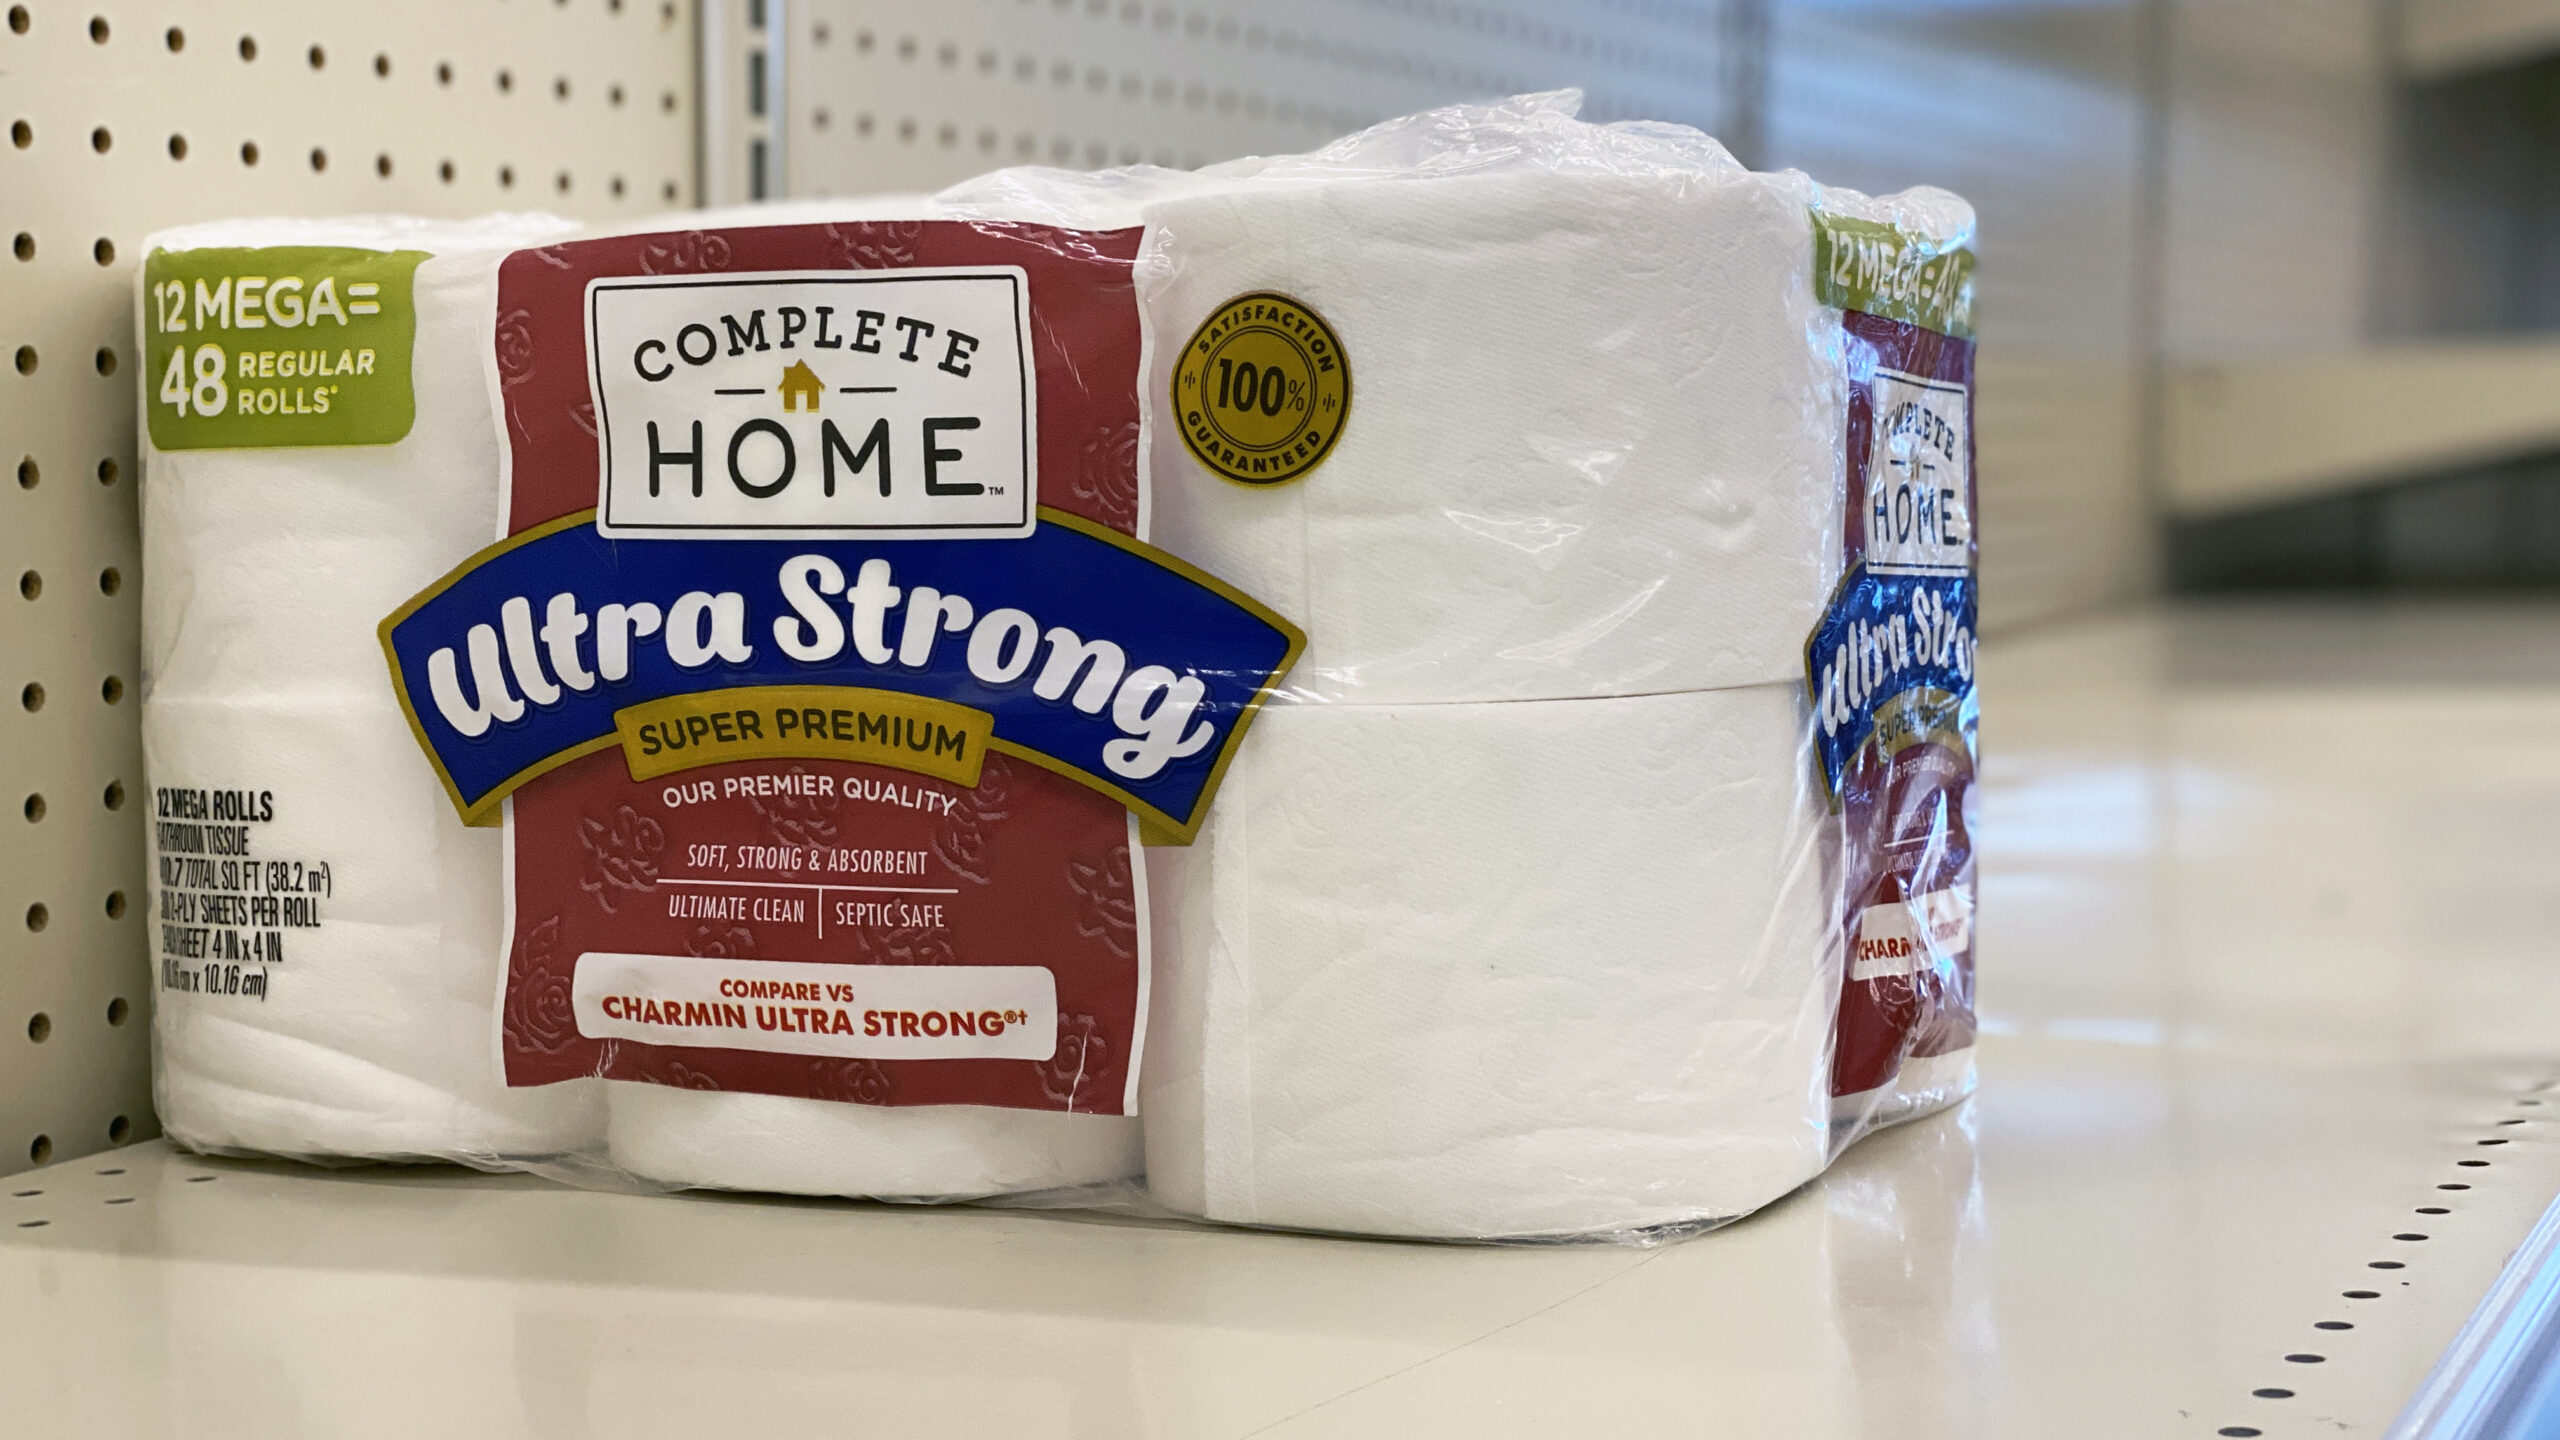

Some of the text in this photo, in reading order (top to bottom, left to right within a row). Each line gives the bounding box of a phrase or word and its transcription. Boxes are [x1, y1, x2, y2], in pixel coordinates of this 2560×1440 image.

[1827, 228, 1853, 287] 12
[154, 276, 380, 333] 12 MEGA=
[634, 306, 979, 382] COMPLETE
[1199, 305, 1335, 373] SATISFACTION
[160, 343, 228, 418] 48
[238, 349, 376, 378] REGULAR
[1218, 358, 1305, 417] 100%
[1188, 411, 1321, 473] GUARANTEED
[1884, 402, 1955, 462] MPLETE
[647, 417, 985, 498] HOME
[1873, 483, 1957, 545] HOME
[773, 554, 1215, 779] Strong
[639, 708, 966, 761] SUPER PREMIUM
[157, 787, 273, 822] 12 MEGA ROLLS
[663, 775, 957, 816] OUR PREMIER QUALITY
[205, 825, 249, 856] TISSUE
[688, 844, 927, 875] SOFT, STRONG & ABSORBENT
[186, 858, 218, 890] TOTAL
[221, 860, 240, 891] SQ
[243, 861, 260, 891] FT
[266, 861, 303, 898] (38.2
[200, 894, 248, 926] SHEETS
[251, 896, 279, 927] PER
[284, 896, 321, 927] ROLL
[669, 894, 804, 923] ULTIMATE CLEAN
[836, 902, 944, 928] SEPTIC SAFE
[212, 929, 222, 959] 4
[225, 930, 239, 960] IN
[254, 931, 262, 962] 4
[266, 931, 282, 962] IN
[204, 964, 239, 995] 10.16
[242, 966, 268, 1002] cm)
[720, 979, 853, 1003] COMPARE VS
[602, 997, 747, 1029] CHARMIN
[756, 1006, 853, 1035] ULTRA
